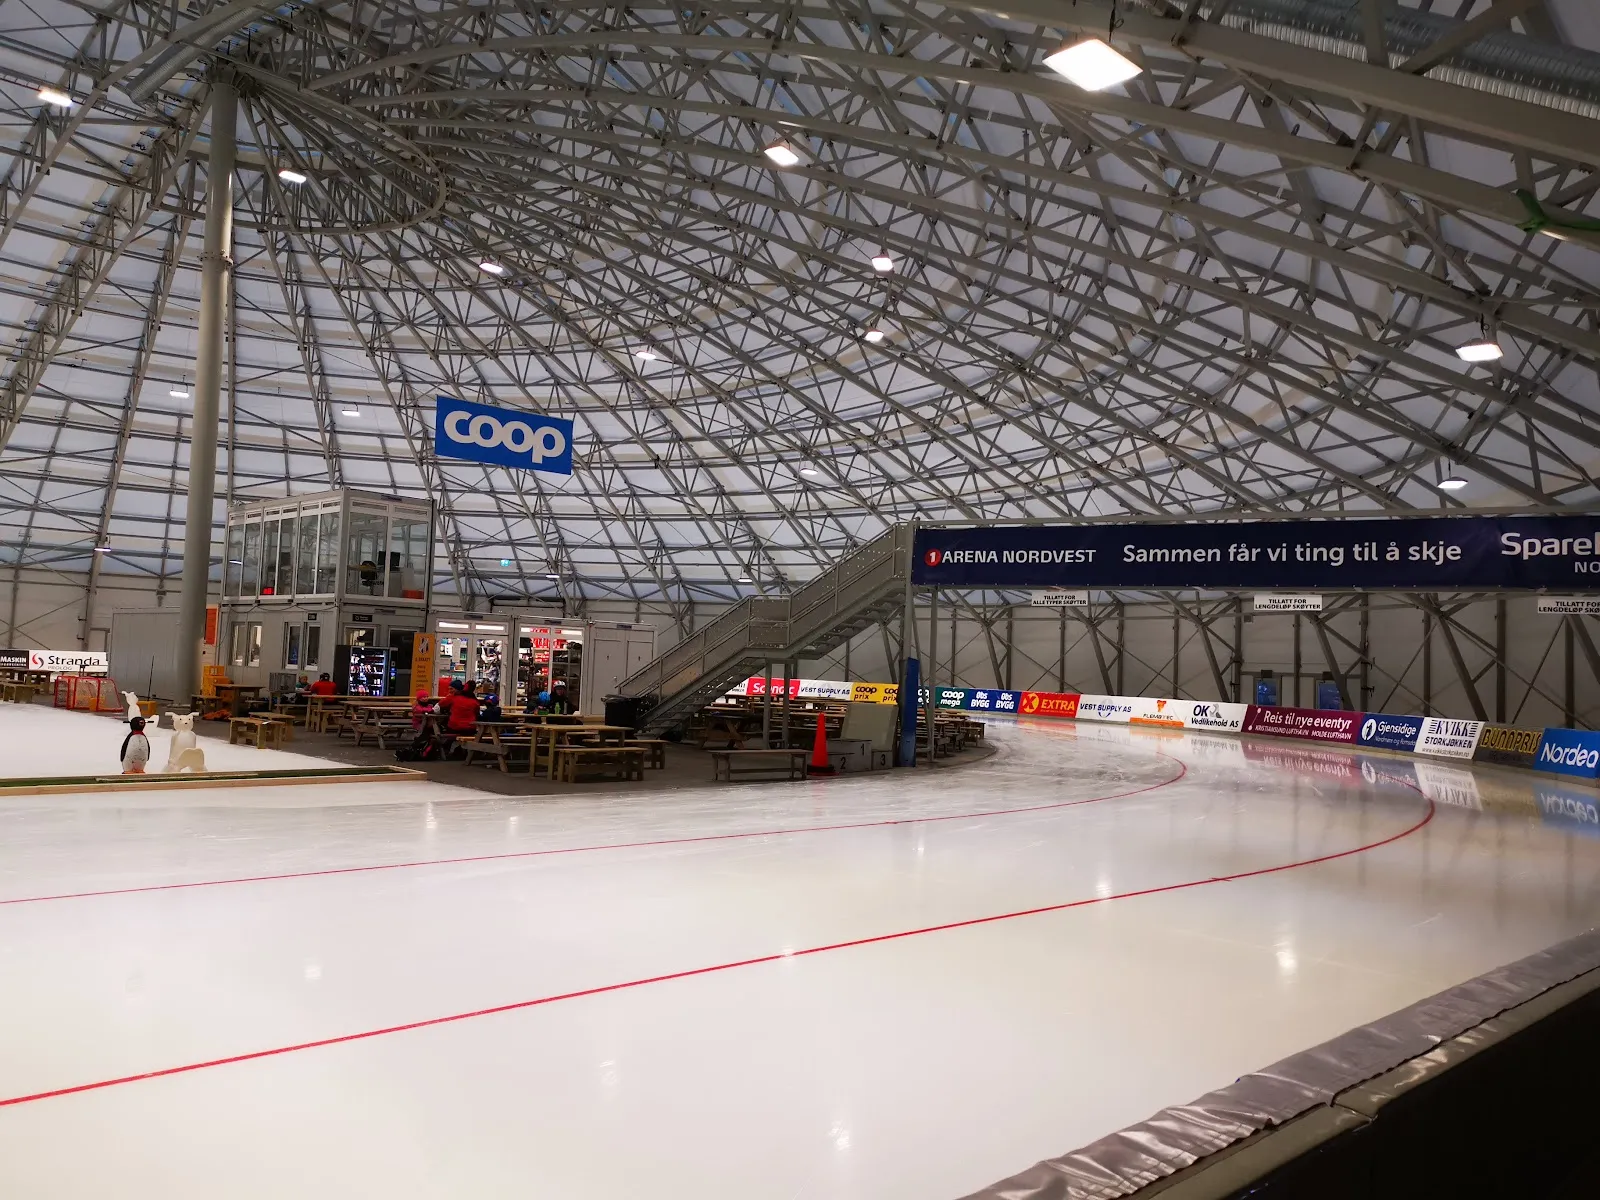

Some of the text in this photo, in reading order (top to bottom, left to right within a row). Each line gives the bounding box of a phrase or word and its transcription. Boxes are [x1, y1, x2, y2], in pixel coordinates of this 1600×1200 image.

[444, 410, 566, 464] coop
[1501, 532, 1600, 560] Spare
[941, 550, 999, 564] ARENA
[1002, 549, 1097, 563] NORDVEST
[1123, 540, 1462, 567] Sammen får vi ting til å skje
[47, 655, 100, 666] Stranda
[817, 687, 841, 695] SUPPLY
[855, 685, 877, 695] coop
[941, 690, 965, 700] coop
[853, 693, 870, 701] prix
[940, 699, 961, 707] mega
[970, 699, 990, 708] BYGG
[995, 700, 1015, 710] BYGG
[1041, 698, 1075, 711] EXTRA
[1080, 703, 1132, 713] VEST SUPPLY AS
[1193, 704, 1211, 717] OK
[1191, 717, 1240, 728] Vedlikehold AS
[1263, 710, 1353, 732] Reis til nye eventyr
[1377, 721, 1417, 738] Gjensidige
[1435, 720, 1472, 737] KVIKK
[1424, 736, 1474, 749] STORKJØKKEN
[879, 753, 887, 767] 3
[1540, 742, 1600, 769] Nordea
[840, 756, 847, 770] 2
